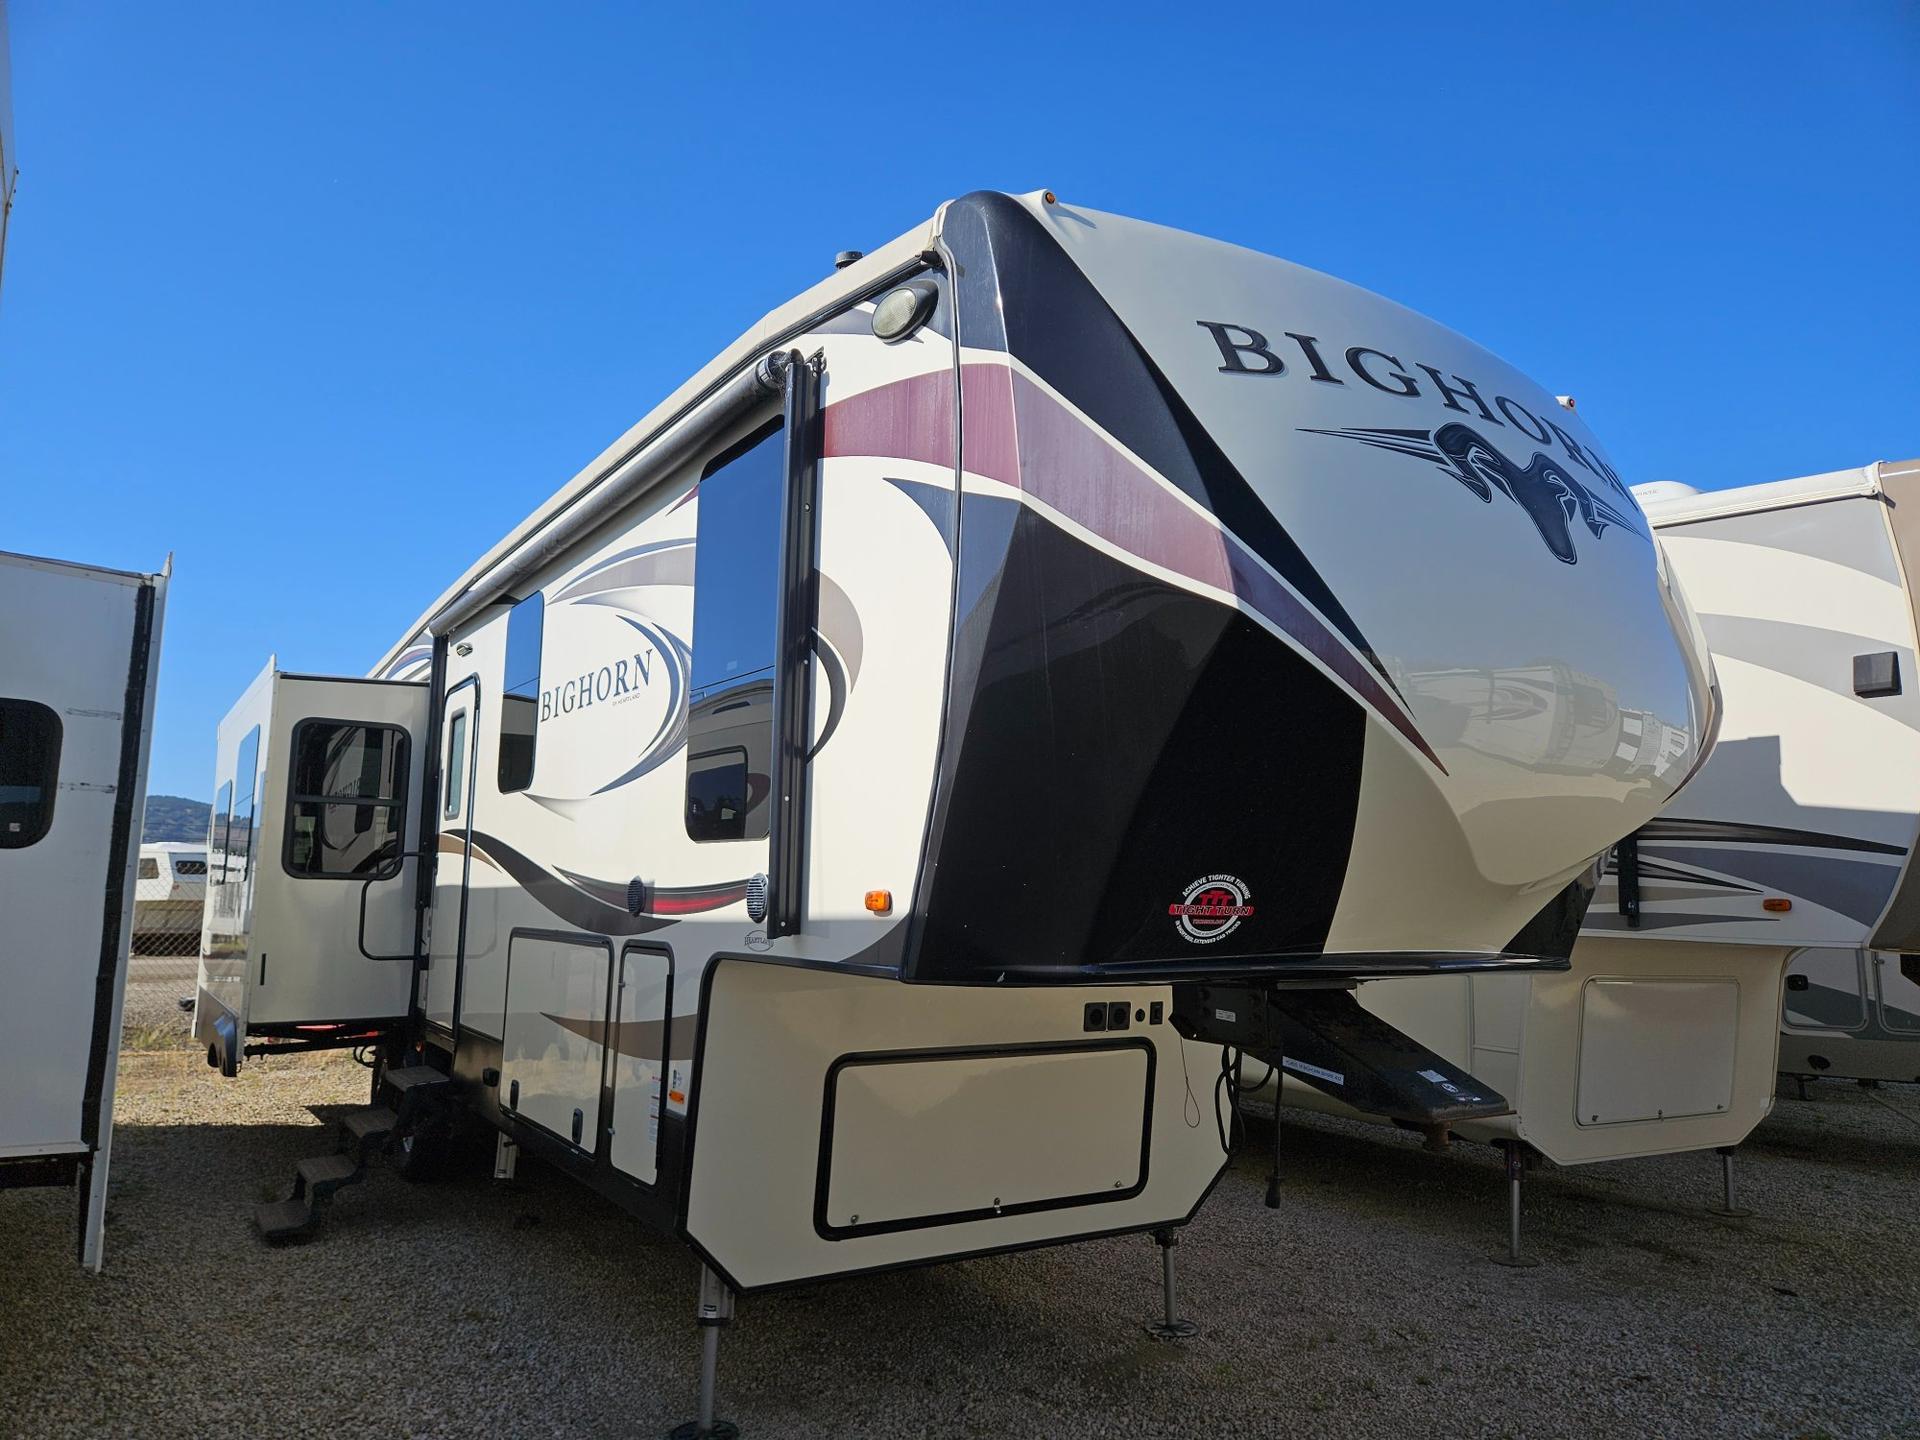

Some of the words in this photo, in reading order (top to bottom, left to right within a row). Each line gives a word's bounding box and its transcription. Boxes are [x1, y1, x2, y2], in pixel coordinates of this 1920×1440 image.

[1196, 320, 1640, 513] BIGHORN
[540, 648, 653, 722] BIGHORN
[1174, 904, 1213, 915] TIGHT
[1215, 905, 1250, 916] TURN
[1182, 876, 1207, 898] ACHIEVE
[1207, 874, 1236, 883] TIGHTER
[1234, 878, 1251, 900] TURNING
